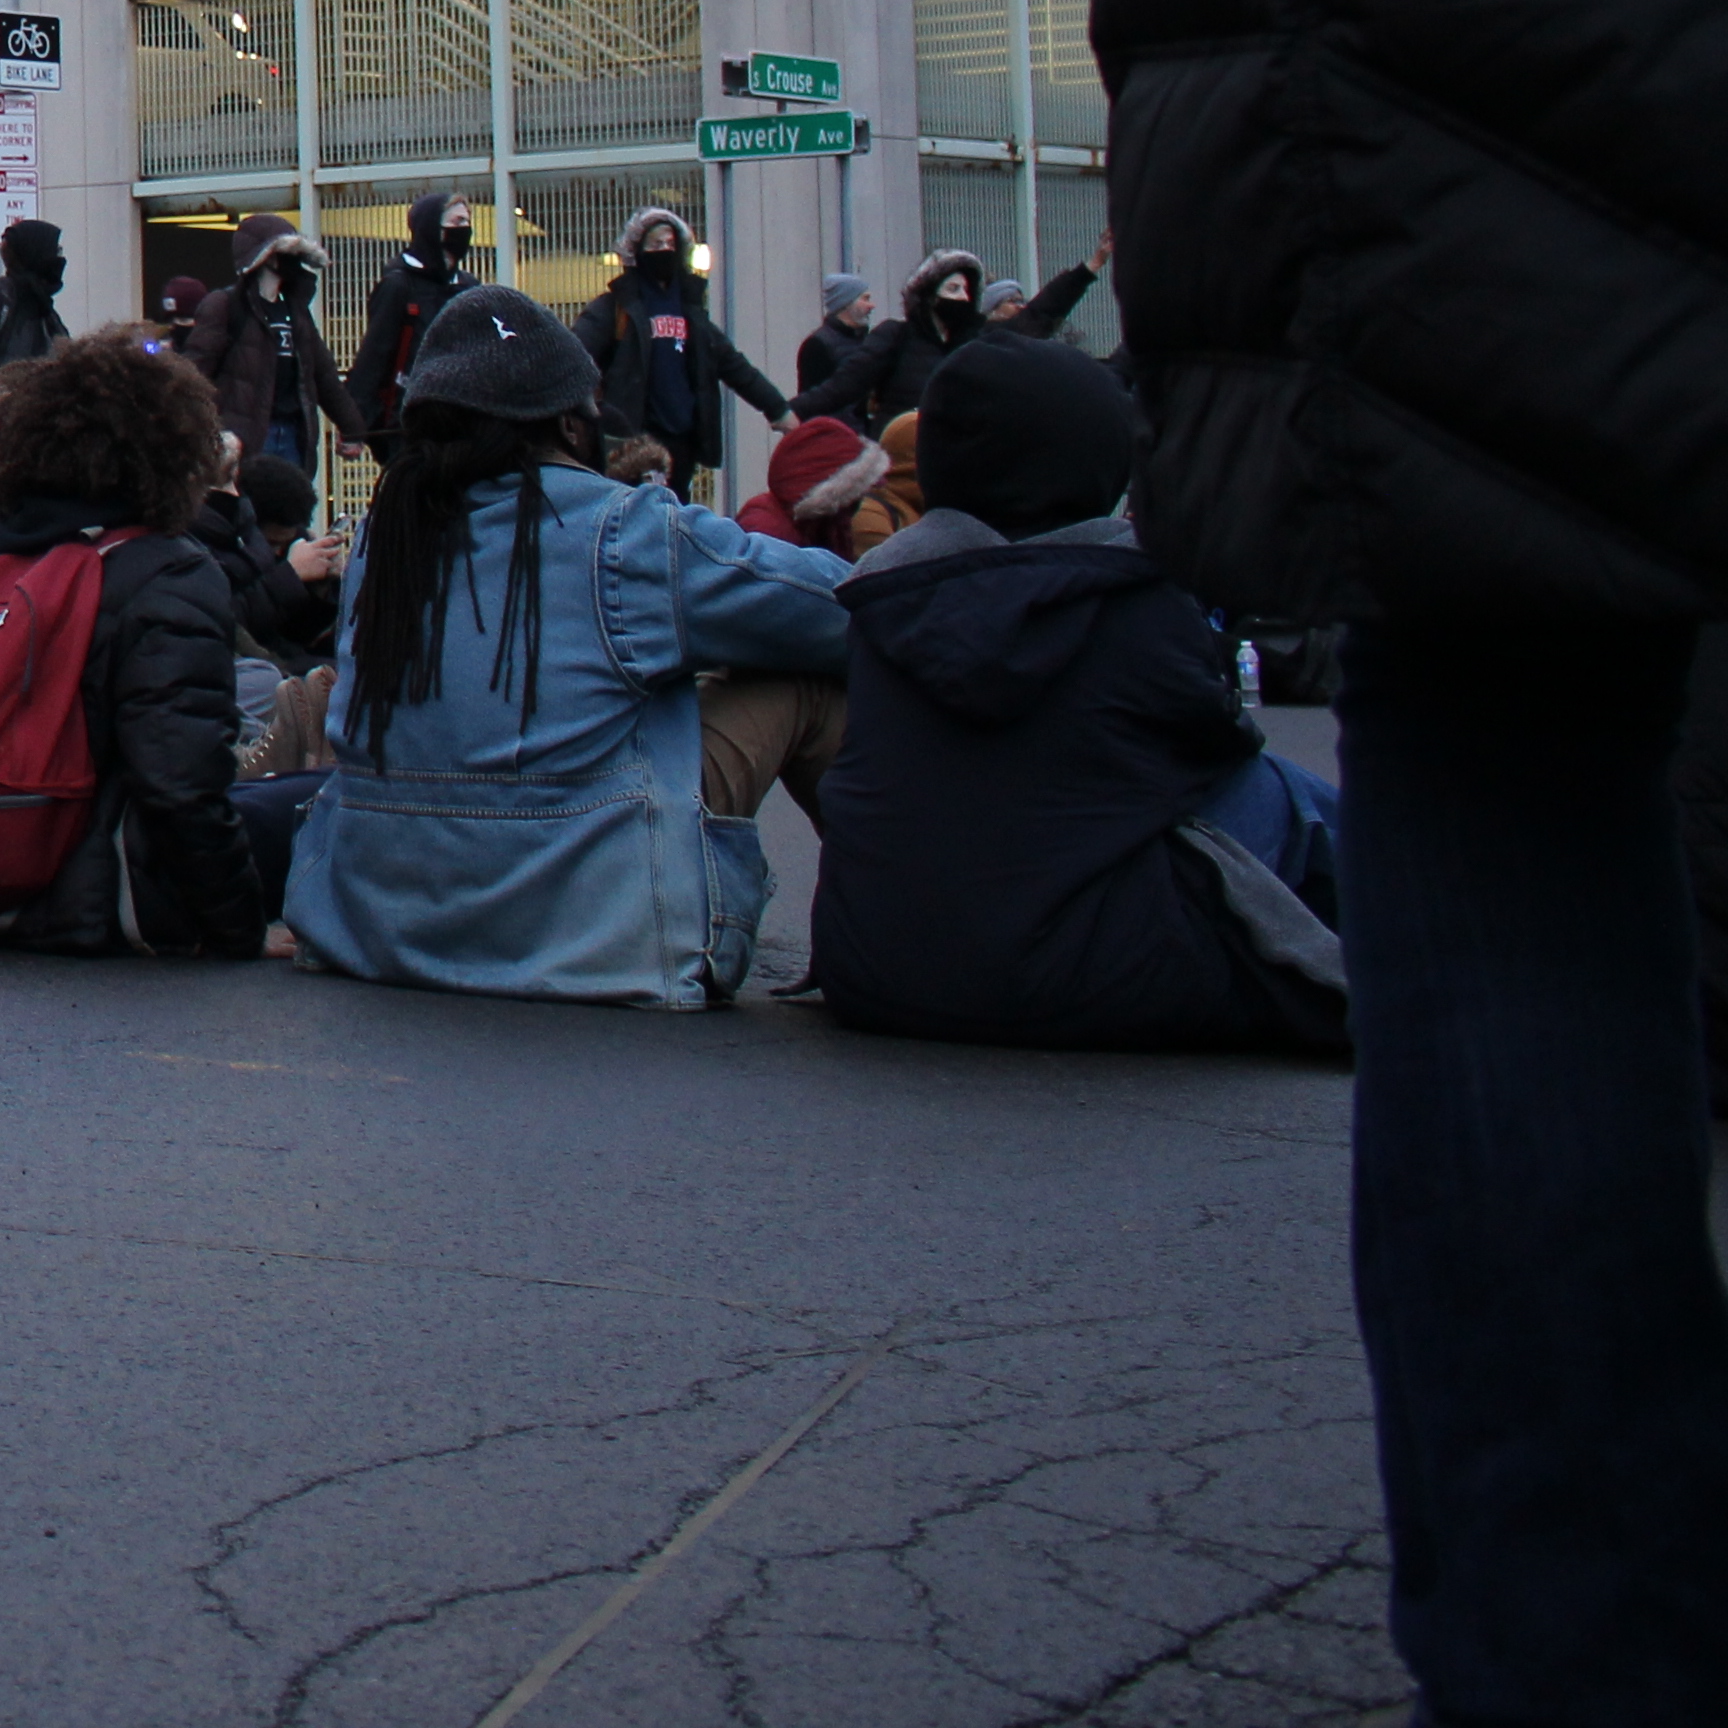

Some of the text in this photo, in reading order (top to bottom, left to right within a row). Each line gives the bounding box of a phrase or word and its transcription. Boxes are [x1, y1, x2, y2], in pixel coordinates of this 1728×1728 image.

[6, 65, 53, 82] BIKE LANE
[767, 63, 813, 94] Crouse
[4, 99, 35, 109] STOPPING
[22, 123, 33, 133] TO
[710, 122, 844, 153] Waverly Ave
[6, 176, 36, 186] STOPPING
[6, 200, 24, 210] ANY
